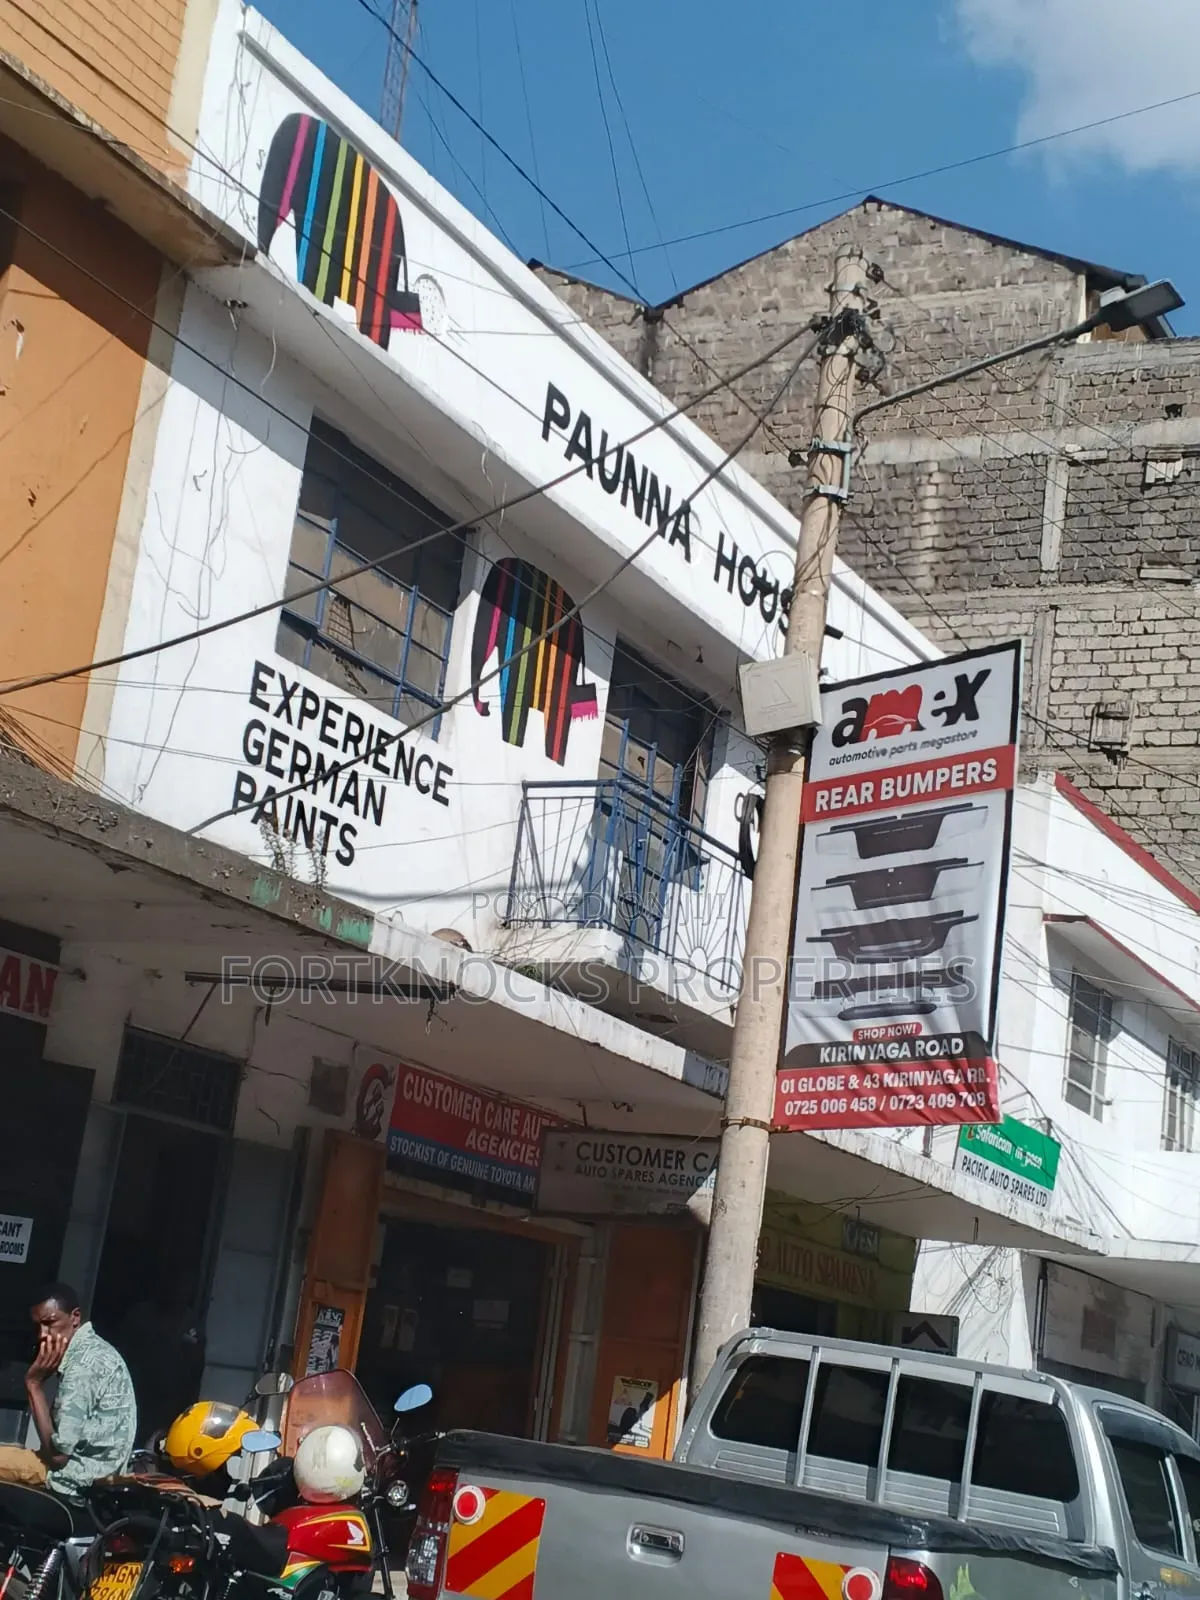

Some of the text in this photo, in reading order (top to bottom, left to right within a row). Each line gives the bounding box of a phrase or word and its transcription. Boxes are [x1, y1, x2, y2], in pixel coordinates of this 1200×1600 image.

[542, 381, 793, 637] PAUNNA HOUS
[249, 660, 453, 807] EXPERIENCE
[829, 729, 978, 766] automotive parts megastore
[242, 719, 387, 826] GERMAN
[815, 758, 997, 813] REAR BUMPERS
[232, 770, 358, 867] PAINTS
[819, 1037, 964, 1063] KIRINYAGA ROAD
[858, 1024, 917, 1040] SHOP NOW!
[798, 1075, 845, 1093] GLOBE
[848, 1075, 860, 1089] &
[863, 1073, 880, 1088] 43
[883, 1069, 962, 1087] KIRINYAGA
[403, 1072, 482, 1124] CUSTOMER
[484, 1102, 520, 1136] CARE
[784, 1100, 817, 1116] 0725
[820, 1099, 847, 1114] 006
[850, 1096, 876, 1111] 458
[879, 1096, 887, 1112] /
[889, 1094, 925, 1111] 0723
[928, 1093, 956, 1109] 409
[389, 1135, 437, 1166] STOCKIST
[437, 1148, 451, 1167] OF
[450, 1154, 490, 1180] GENUINE
[490, 1166, 522, 1189] TOYOTA
[576, 1141, 720, 1173] CUSTOMER CA
[975, 1125, 1013, 1156] Safaricom
[574, 1163, 608, 1179] AUTO
[611, 1168, 654, 1184] SPARES
[658, 1173, 717, 1190] AGENCIE
[961, 1155, 1048, 1208] PACIFIC AUTO SPARES LTD
